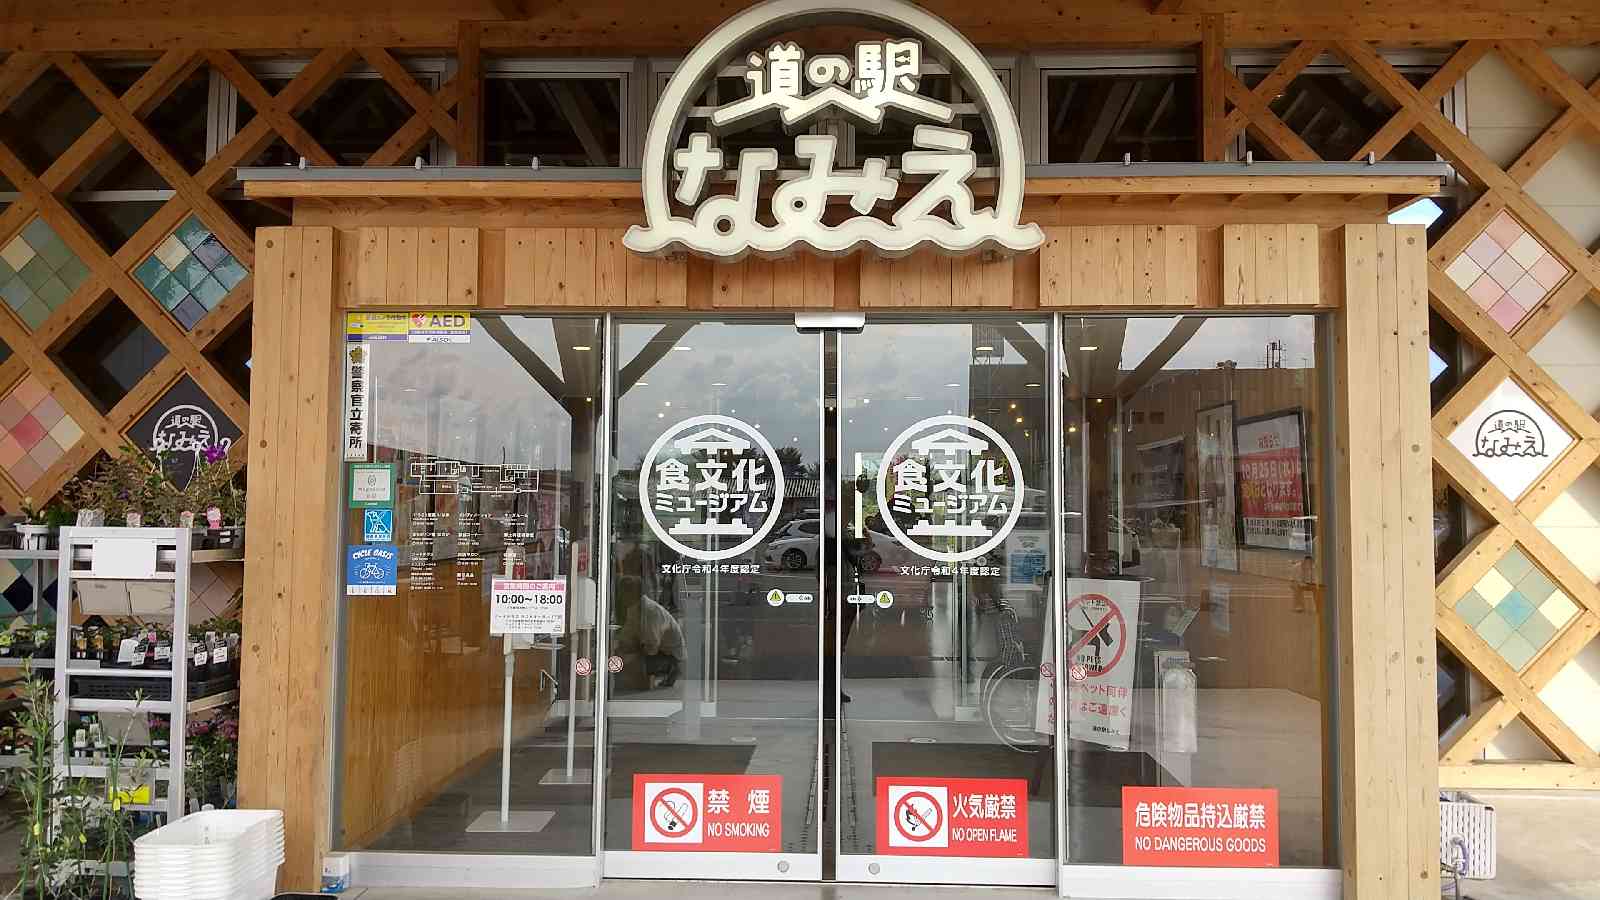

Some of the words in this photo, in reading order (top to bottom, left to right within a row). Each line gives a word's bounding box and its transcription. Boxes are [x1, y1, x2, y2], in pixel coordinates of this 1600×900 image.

[745, 39, 923, 99] 道の駅
[673, 124, 978, 252] なみえ
[430, 314, 466, 328] AED
[1494, 419, 1526, 429] 道の駅
[1481, 435, 1537, 457] なみえ
[655, 458, 767, 491] 食文化
[893, 458, 1006, 493] 食文化
[655, 492, 768, 513] ミュージアム
[893, 493, 1008, 514] ミュージアム
[352, 549, 372, 560] CYCLE
[373, 548, 394, 560] OASIS
[661, 564, 761, 574] 文化庁令和4年度認定
[900, 565, 1001, 576] 文化庁令和4年度認定
[952, 794, 1017, 820] 火気厳禁
[1135, 802, 1266, 829] 危険物品持込厳禁
[707, 823, 722, 838] NO
[724, 823, 770, 839] SMOKING
[952, 827, 965, 841] NO
[966, 827, 988, 842] OPEN
[989, 828, 1017, 843] FLAME
[1135, 836, 1151, 850] NO
[1154, 836, 1223, 852] DANGEROUS
[1226, 837, 1266, 853] GOODS
